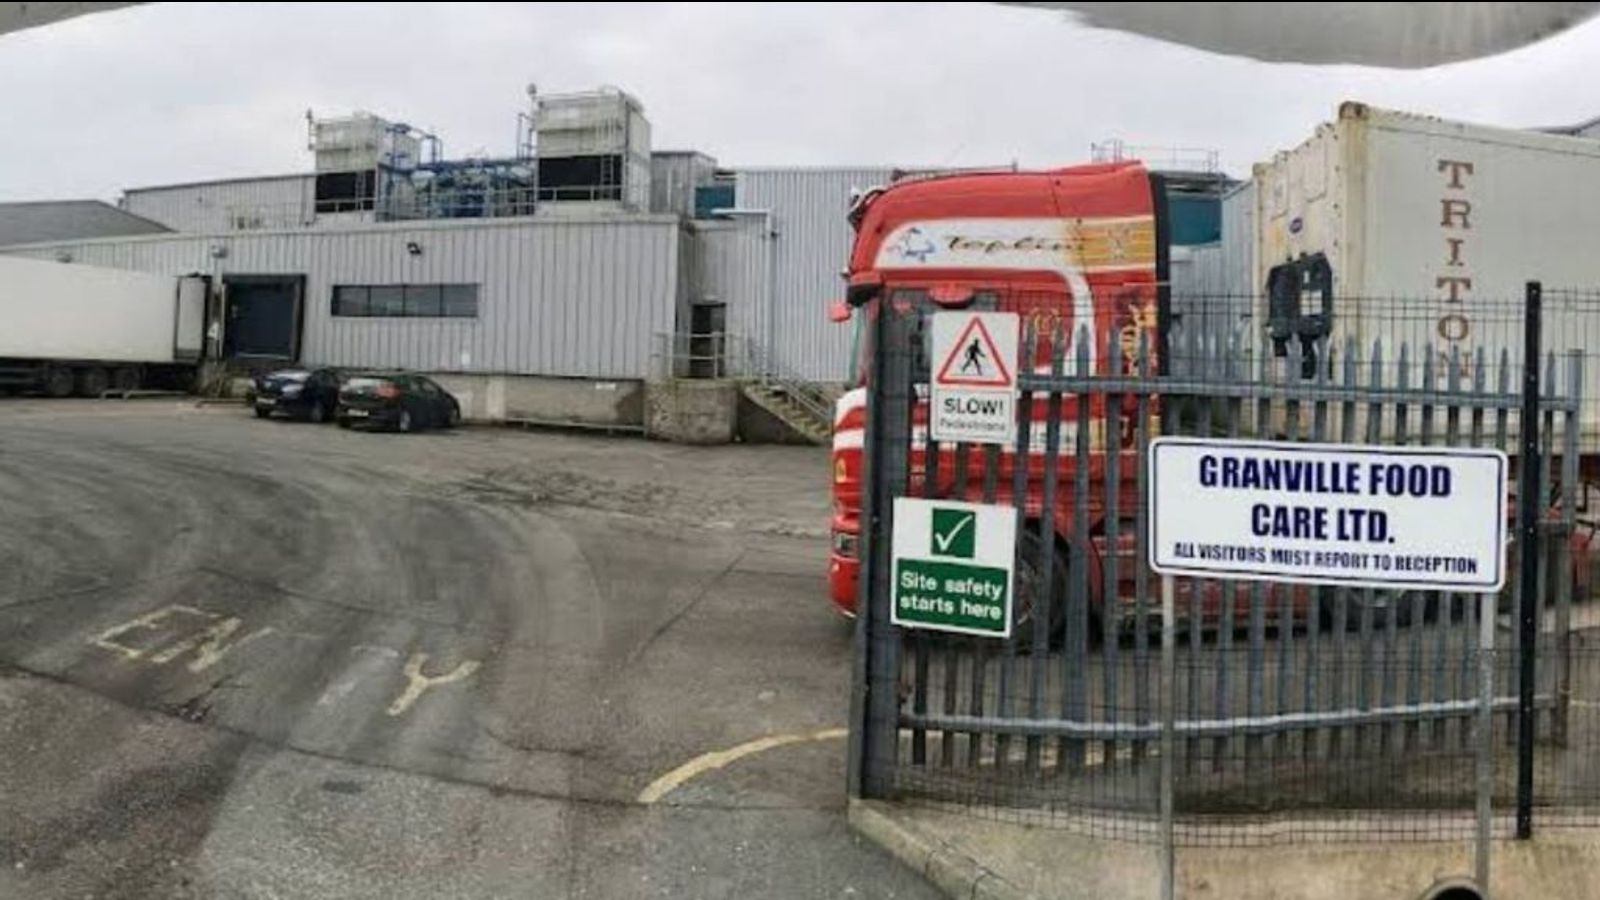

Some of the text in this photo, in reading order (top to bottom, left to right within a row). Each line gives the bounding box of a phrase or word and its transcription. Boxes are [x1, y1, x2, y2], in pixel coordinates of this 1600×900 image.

[1436, 159, 1475, 378] TRITON
[943, 397, 1004, 416] SLOW!
[1199, 454, 1452, 497] GRANVILLE FOOD
[1251, 503, 1395, 543] CARE LTD.
[1173, 541, 1478, 574] ALL VISITORS MUST REPORT TO RECEPTION
[900, 569, 1003, 602] Site safety
[900, 594, 1002, 620] starts here
[88, 604, 482, 717] ENY
